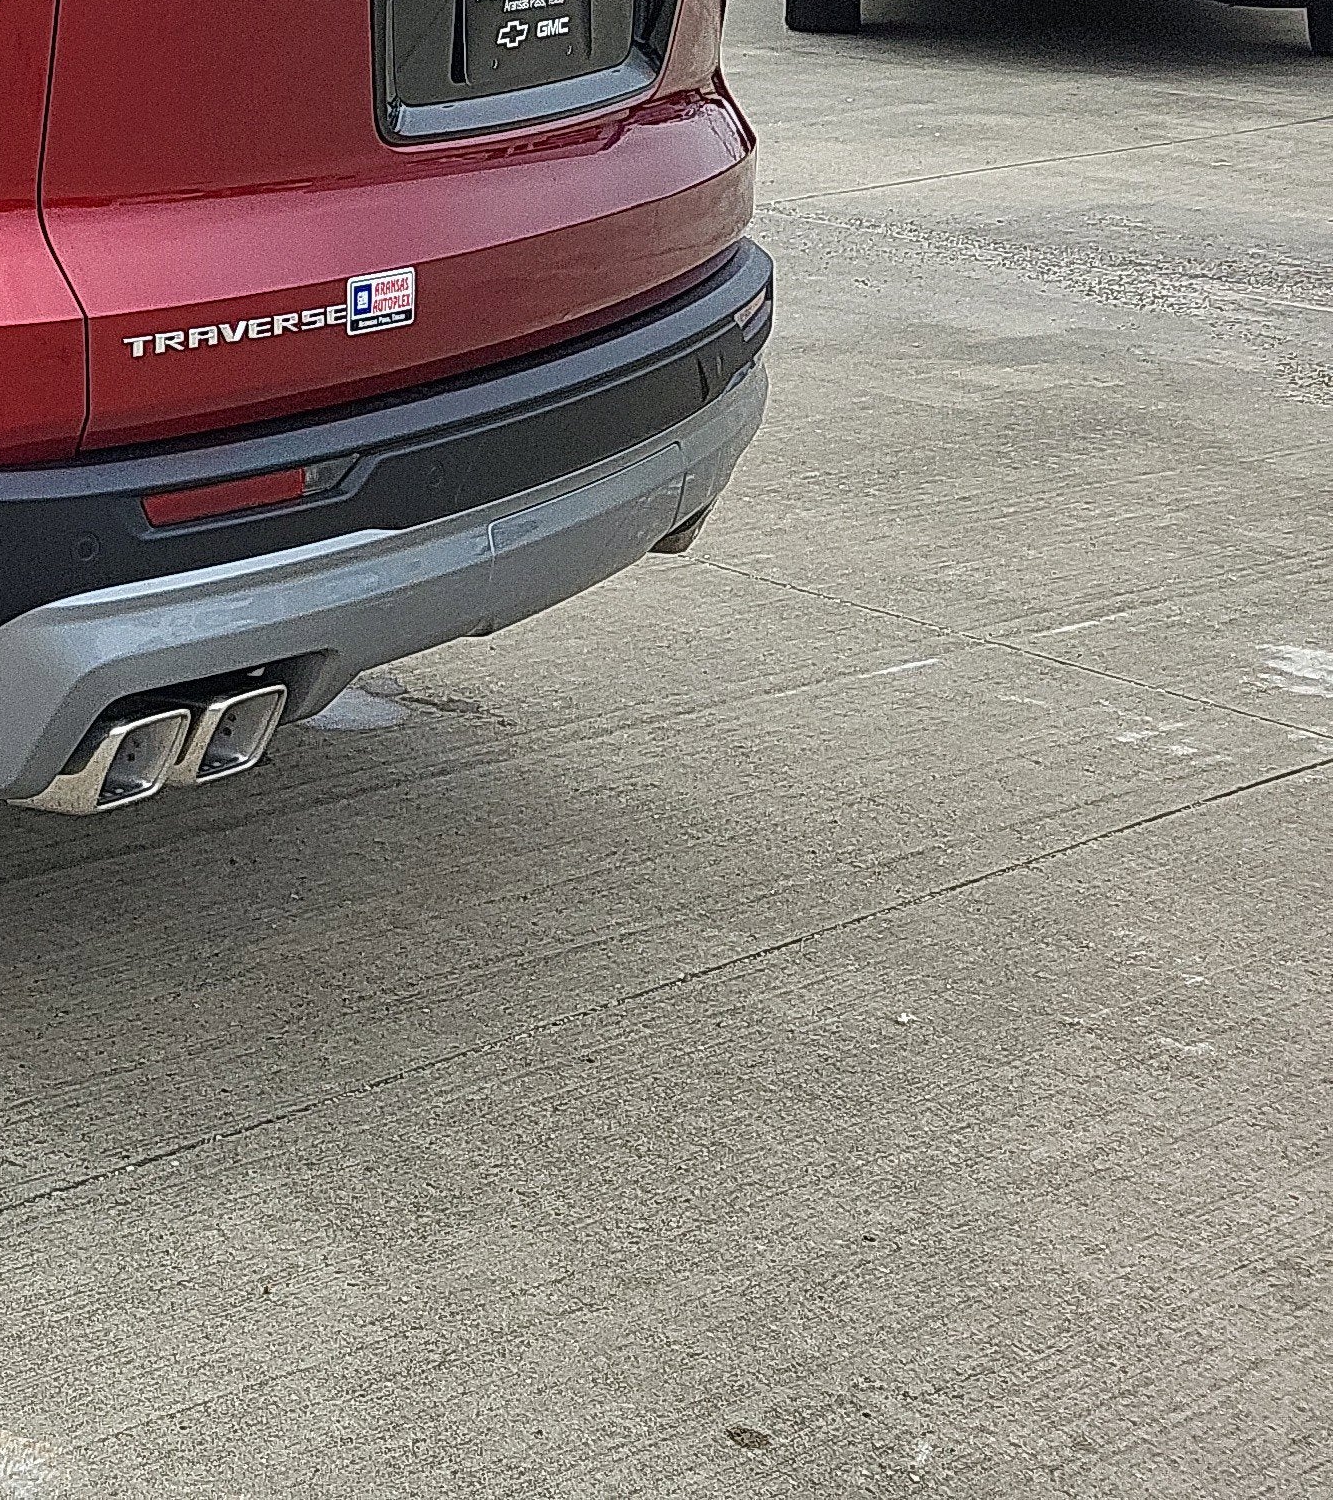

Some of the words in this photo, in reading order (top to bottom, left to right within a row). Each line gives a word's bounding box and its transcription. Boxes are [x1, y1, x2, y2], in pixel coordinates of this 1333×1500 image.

[536, 17, 570, 38] GMC
[374, 277, 409, 298] ARANSAS
[373, 294, 410, 314] AUTOPLEX
[123, 304, 347, 358] TRAVERSE
